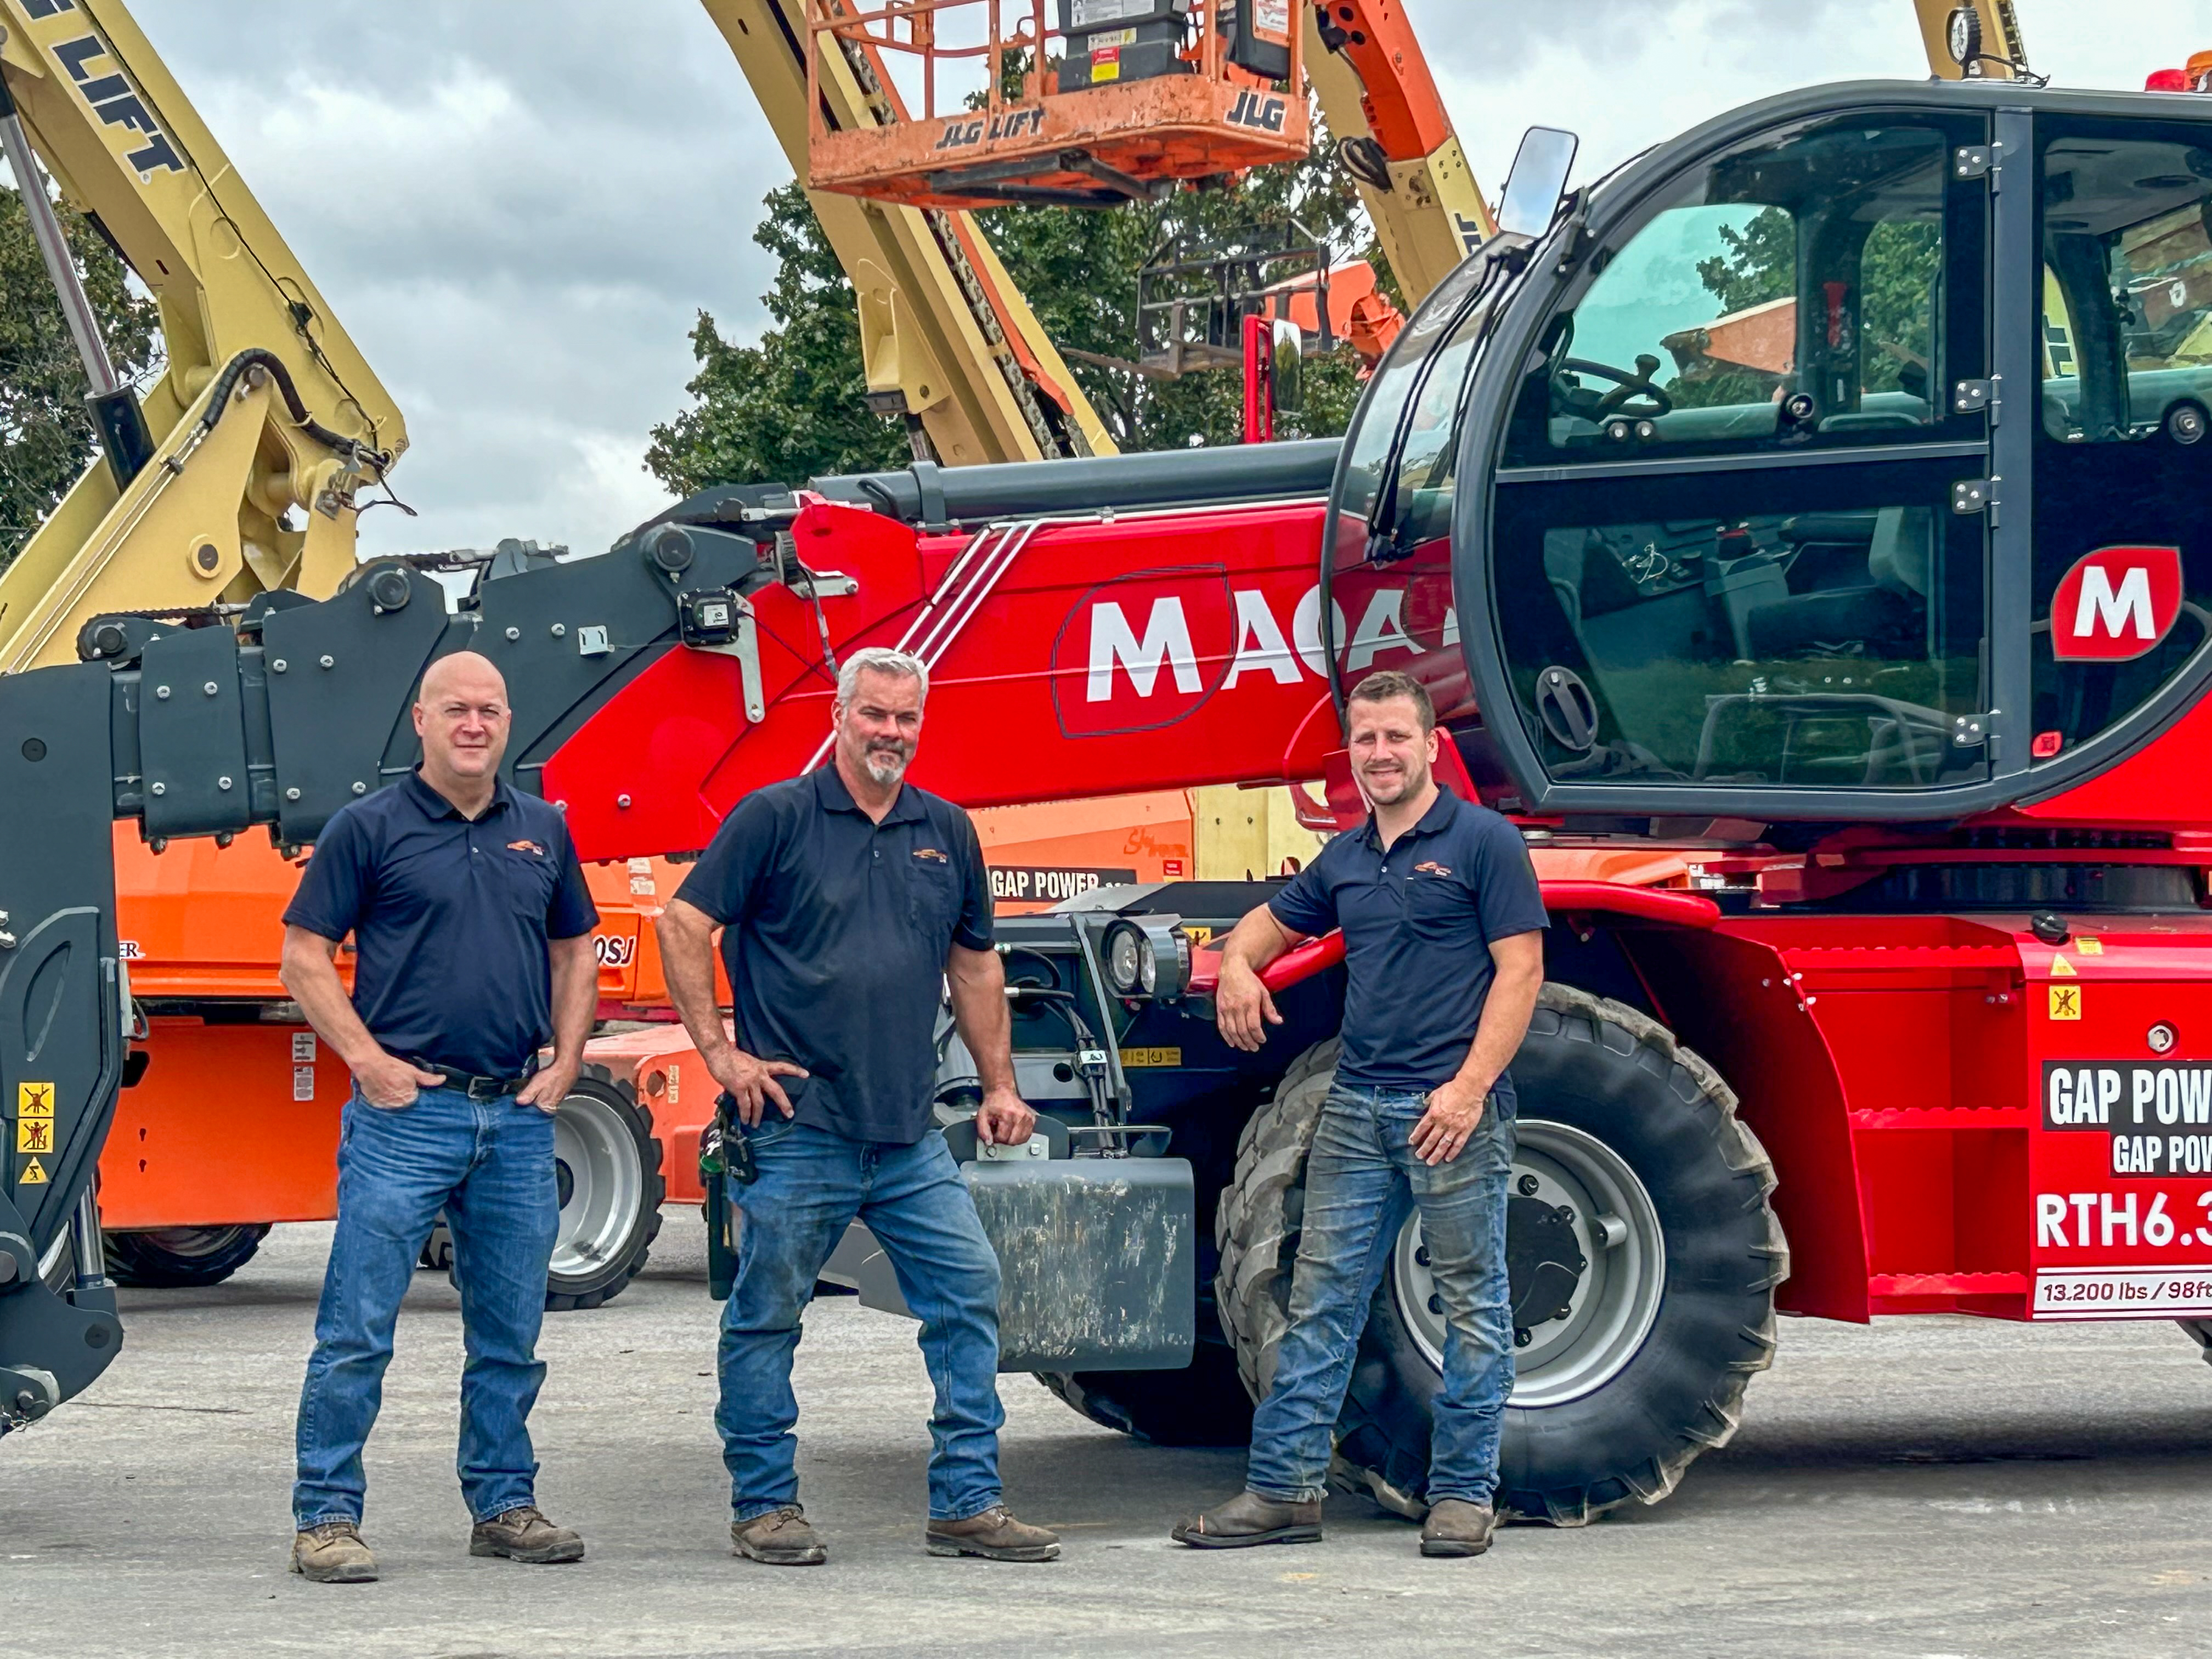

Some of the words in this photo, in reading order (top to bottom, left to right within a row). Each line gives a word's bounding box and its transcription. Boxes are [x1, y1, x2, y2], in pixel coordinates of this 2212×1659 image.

[50, 34, 185, 173] LIFT
[1226, 91, 1285, 132] JLG
[935, 120, 984, 149] JLG
[988, 106, 1046, 140] LIFT
[2073, 566, 2157, 639] M
[991, 870, 1029, 898] GAP
[1034, 871, 1099, 899] POWER
[2049, 1068, 2121, 1125] GAP
[2113, 1135, 2162, 1173] GAP
